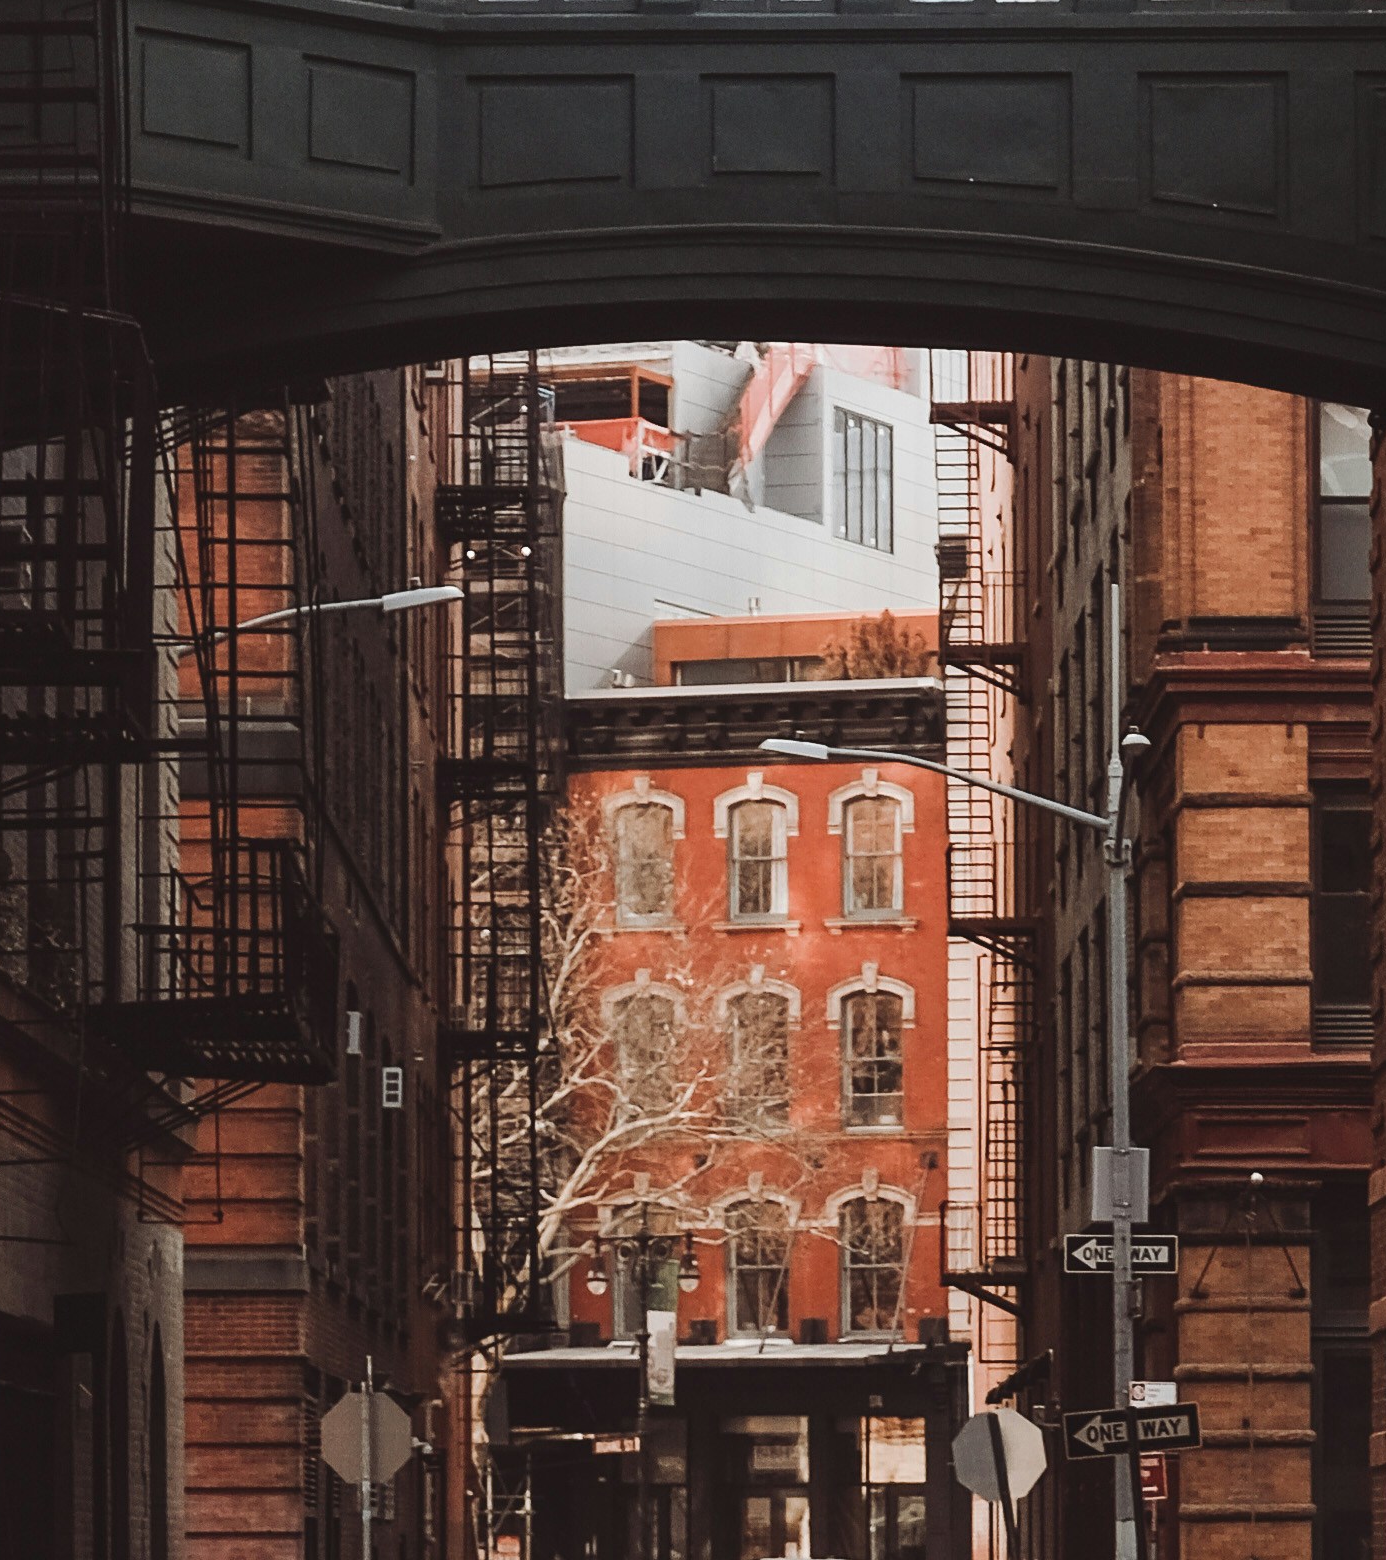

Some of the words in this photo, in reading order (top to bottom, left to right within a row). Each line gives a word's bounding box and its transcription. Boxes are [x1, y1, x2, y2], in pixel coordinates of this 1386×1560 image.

[1083, 1247, 1113, 1261] ONE
[1086, 1424, 1126, 1443] ONE
[1141, 1418, 1182, 1438] WAY
